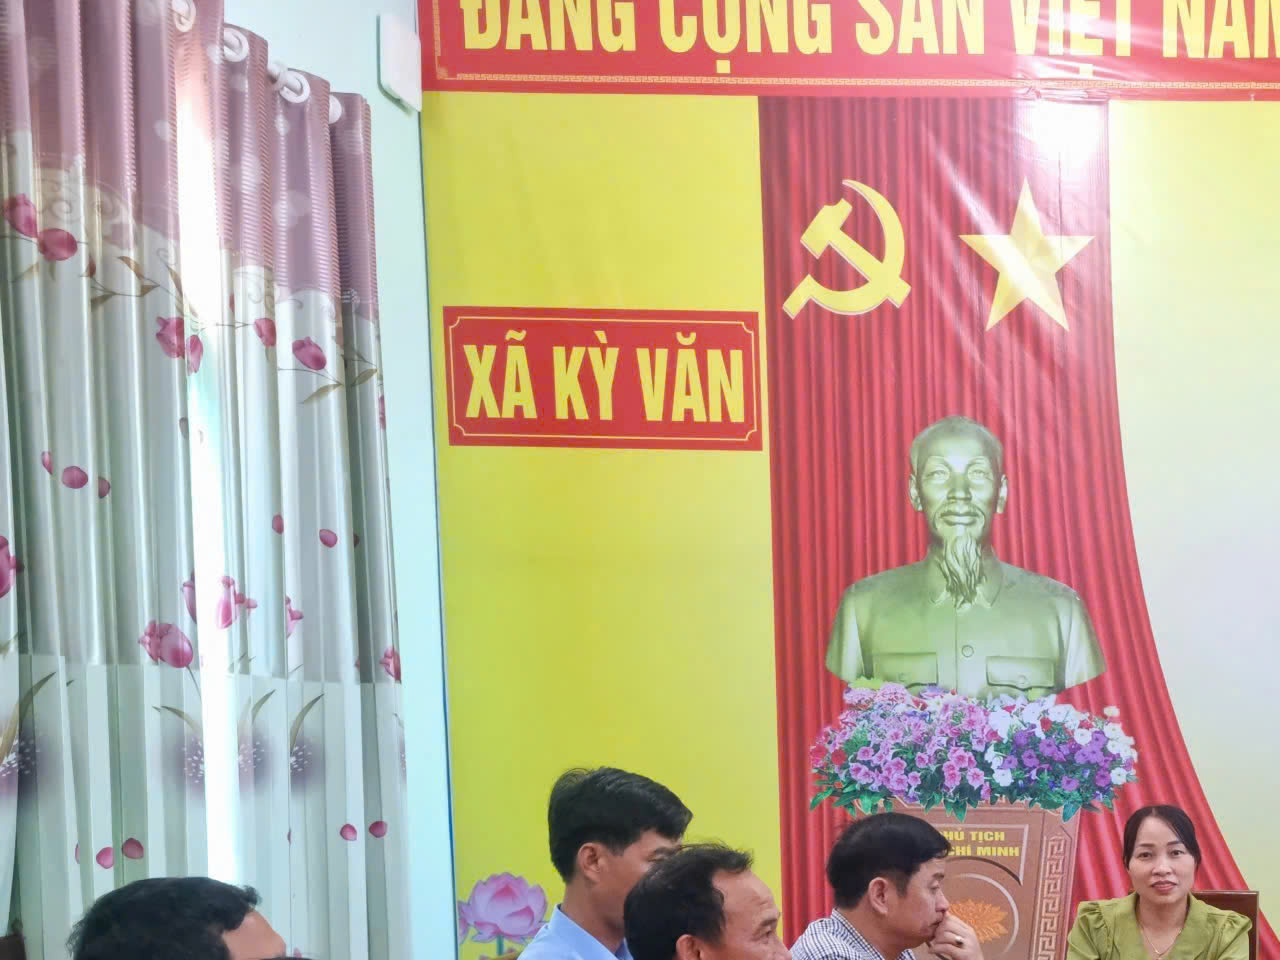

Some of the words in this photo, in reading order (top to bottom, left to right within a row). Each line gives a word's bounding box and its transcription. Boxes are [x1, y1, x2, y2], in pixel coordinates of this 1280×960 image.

[463, 329, 538, 419] XÃ
[552, 330, 620, 421] KỲ
[636, 331, 745, 423] VĂN
[940, 827, 965, 841] HỦ
[970, 831, 1005, 843] TỊCH
[976, 846, 1020, 857] MINH
